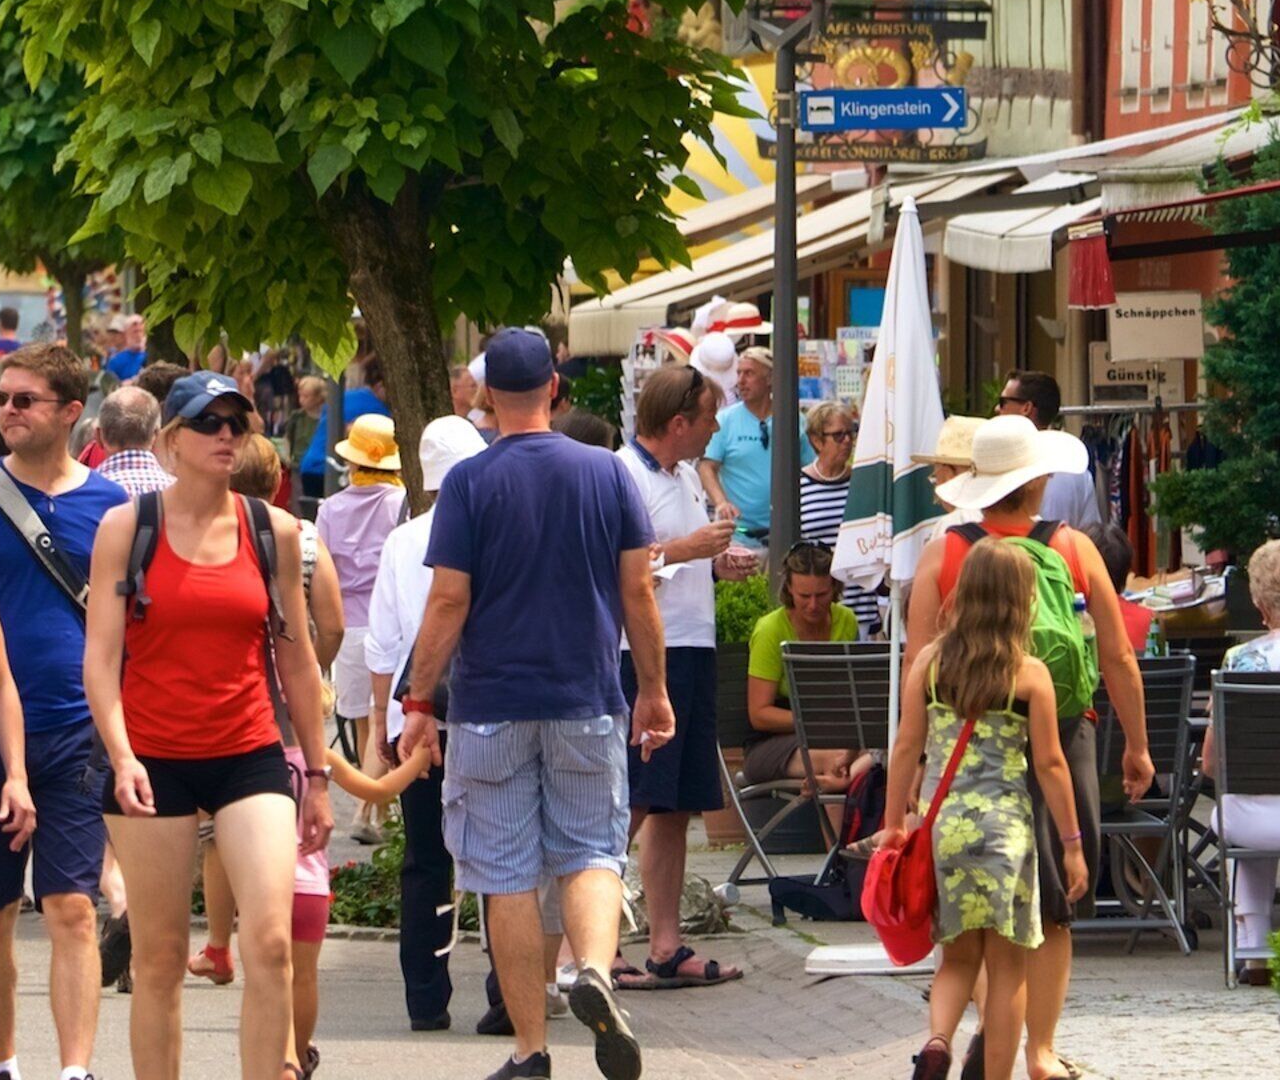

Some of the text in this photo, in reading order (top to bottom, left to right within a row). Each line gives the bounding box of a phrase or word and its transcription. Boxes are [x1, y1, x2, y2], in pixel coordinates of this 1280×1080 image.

[840, 100, 932, 119] Klingenstein
[1115, 308, 1196, 321] Schnäppchen
[1107, 367, 1166, 383] Günstig
